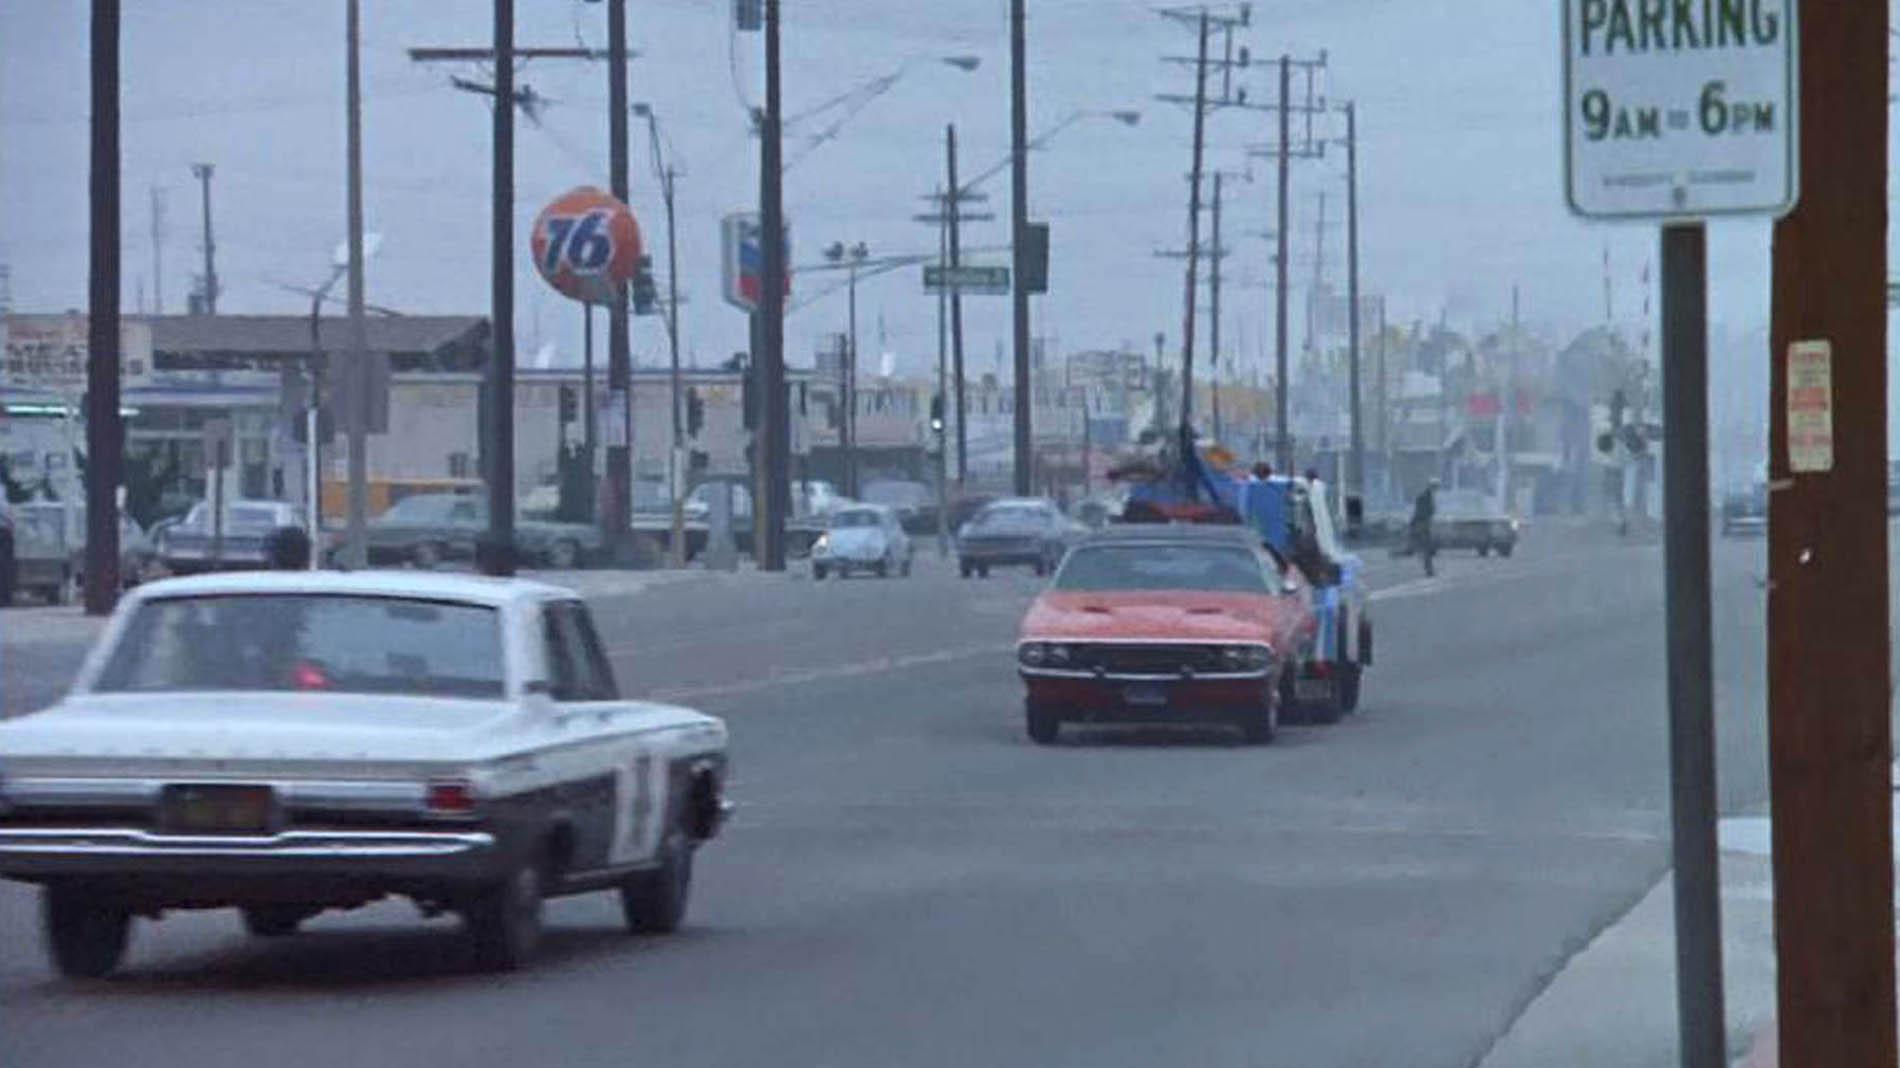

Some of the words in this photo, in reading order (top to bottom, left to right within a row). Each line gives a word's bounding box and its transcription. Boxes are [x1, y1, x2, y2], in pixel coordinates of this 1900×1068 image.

[1580, 0, 1778, 56] PARKING
[1581, 88, 1660, 141] 9AM
[1699, 80, 1774, 136] 6PM
[544, 211, 611, 273] 76
